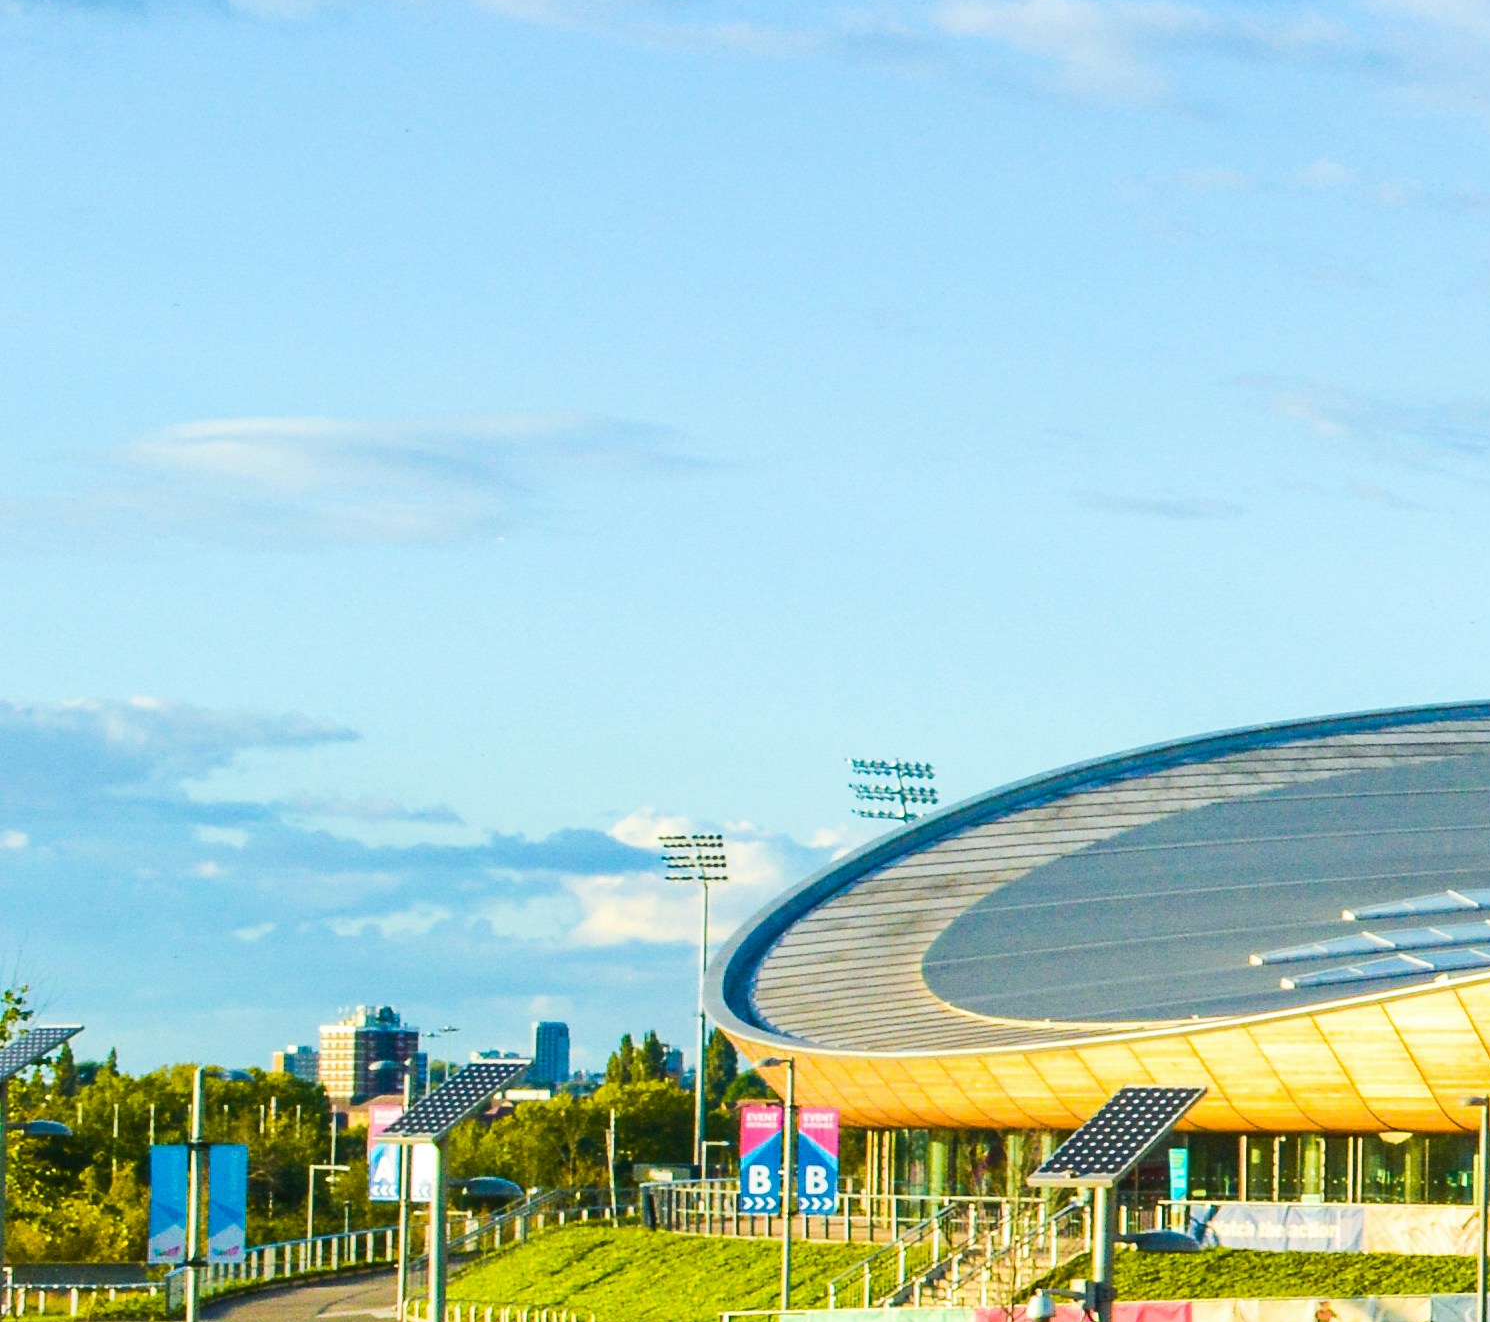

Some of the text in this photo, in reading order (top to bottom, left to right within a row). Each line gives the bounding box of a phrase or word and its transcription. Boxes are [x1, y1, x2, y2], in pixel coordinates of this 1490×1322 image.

[745, 1112, 779, 1123] EVENT
[802, 1112, 835, 1123] EVENT
[373, 1155, 396, 1183] A
[748, 1164, 772, 1195] B
[805, 1164, 829, 1195] B
